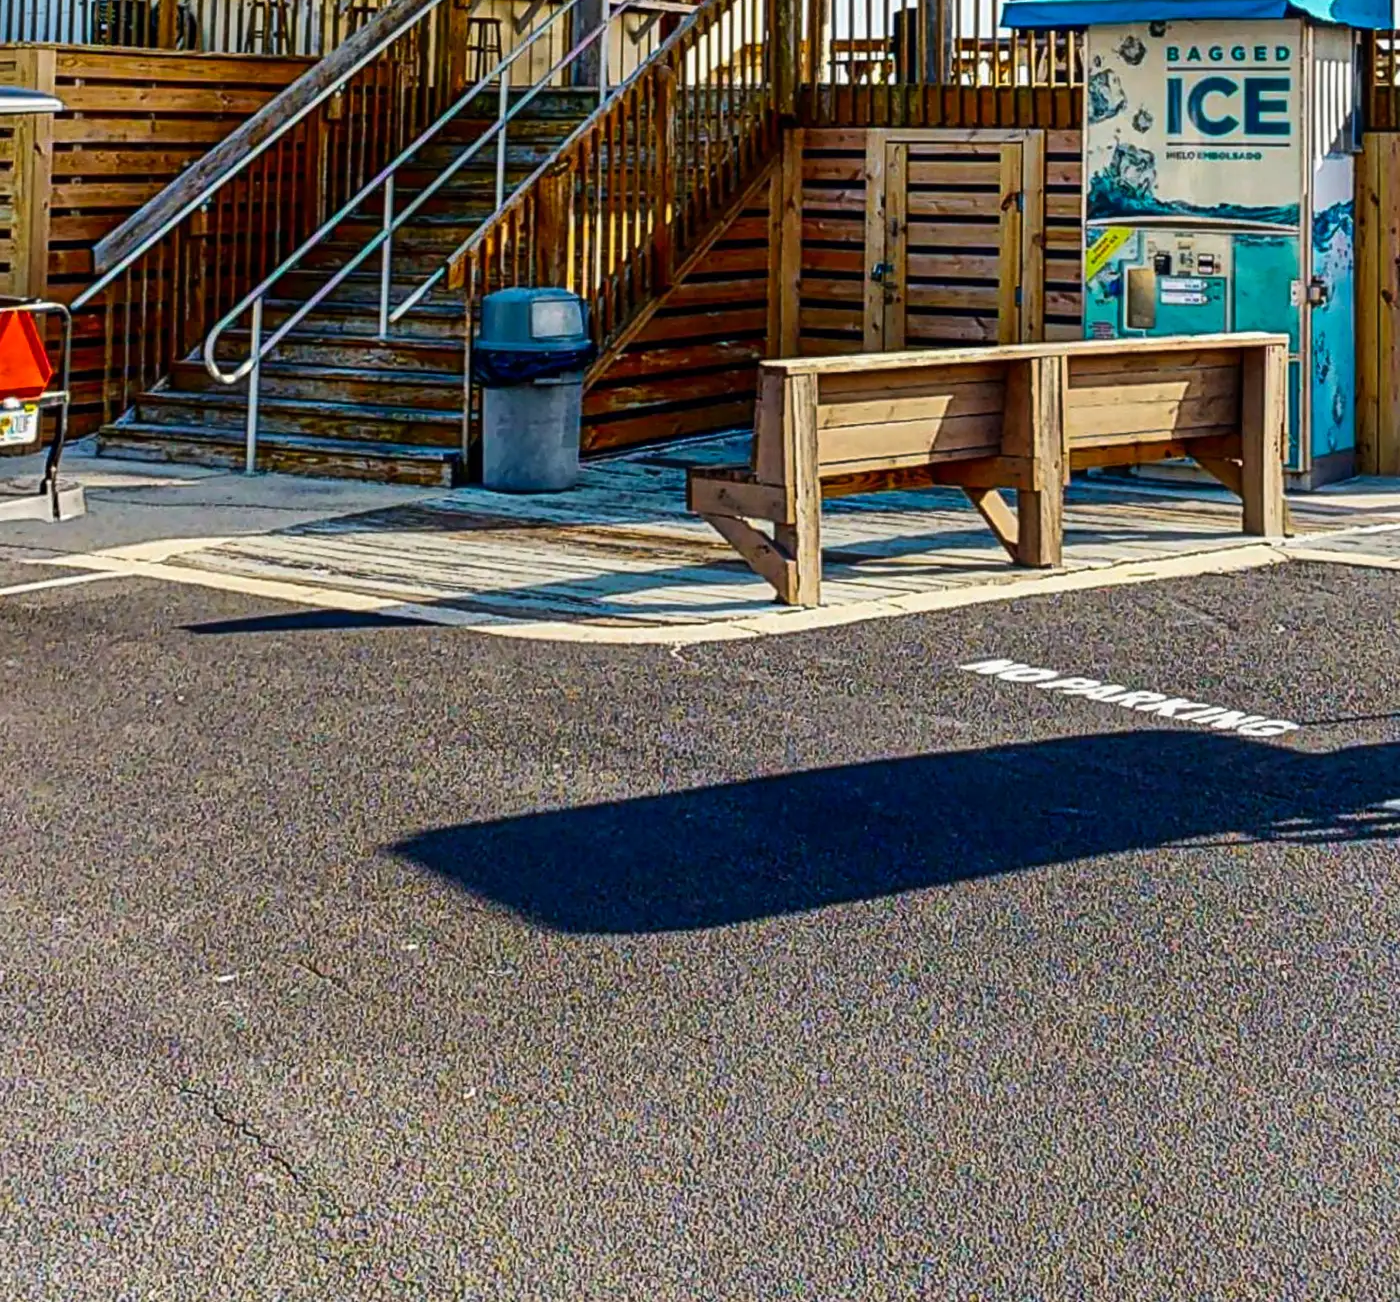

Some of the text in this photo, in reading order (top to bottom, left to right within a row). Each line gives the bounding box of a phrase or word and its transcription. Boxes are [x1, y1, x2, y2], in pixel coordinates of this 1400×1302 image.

[1166, 46, 1291, 62] BAGGED
[1166, 76, 1291, 136] ICE
[1166, 151, 1196, 160] HIELO
[959, 659, 1300, 737] NO PARKING
